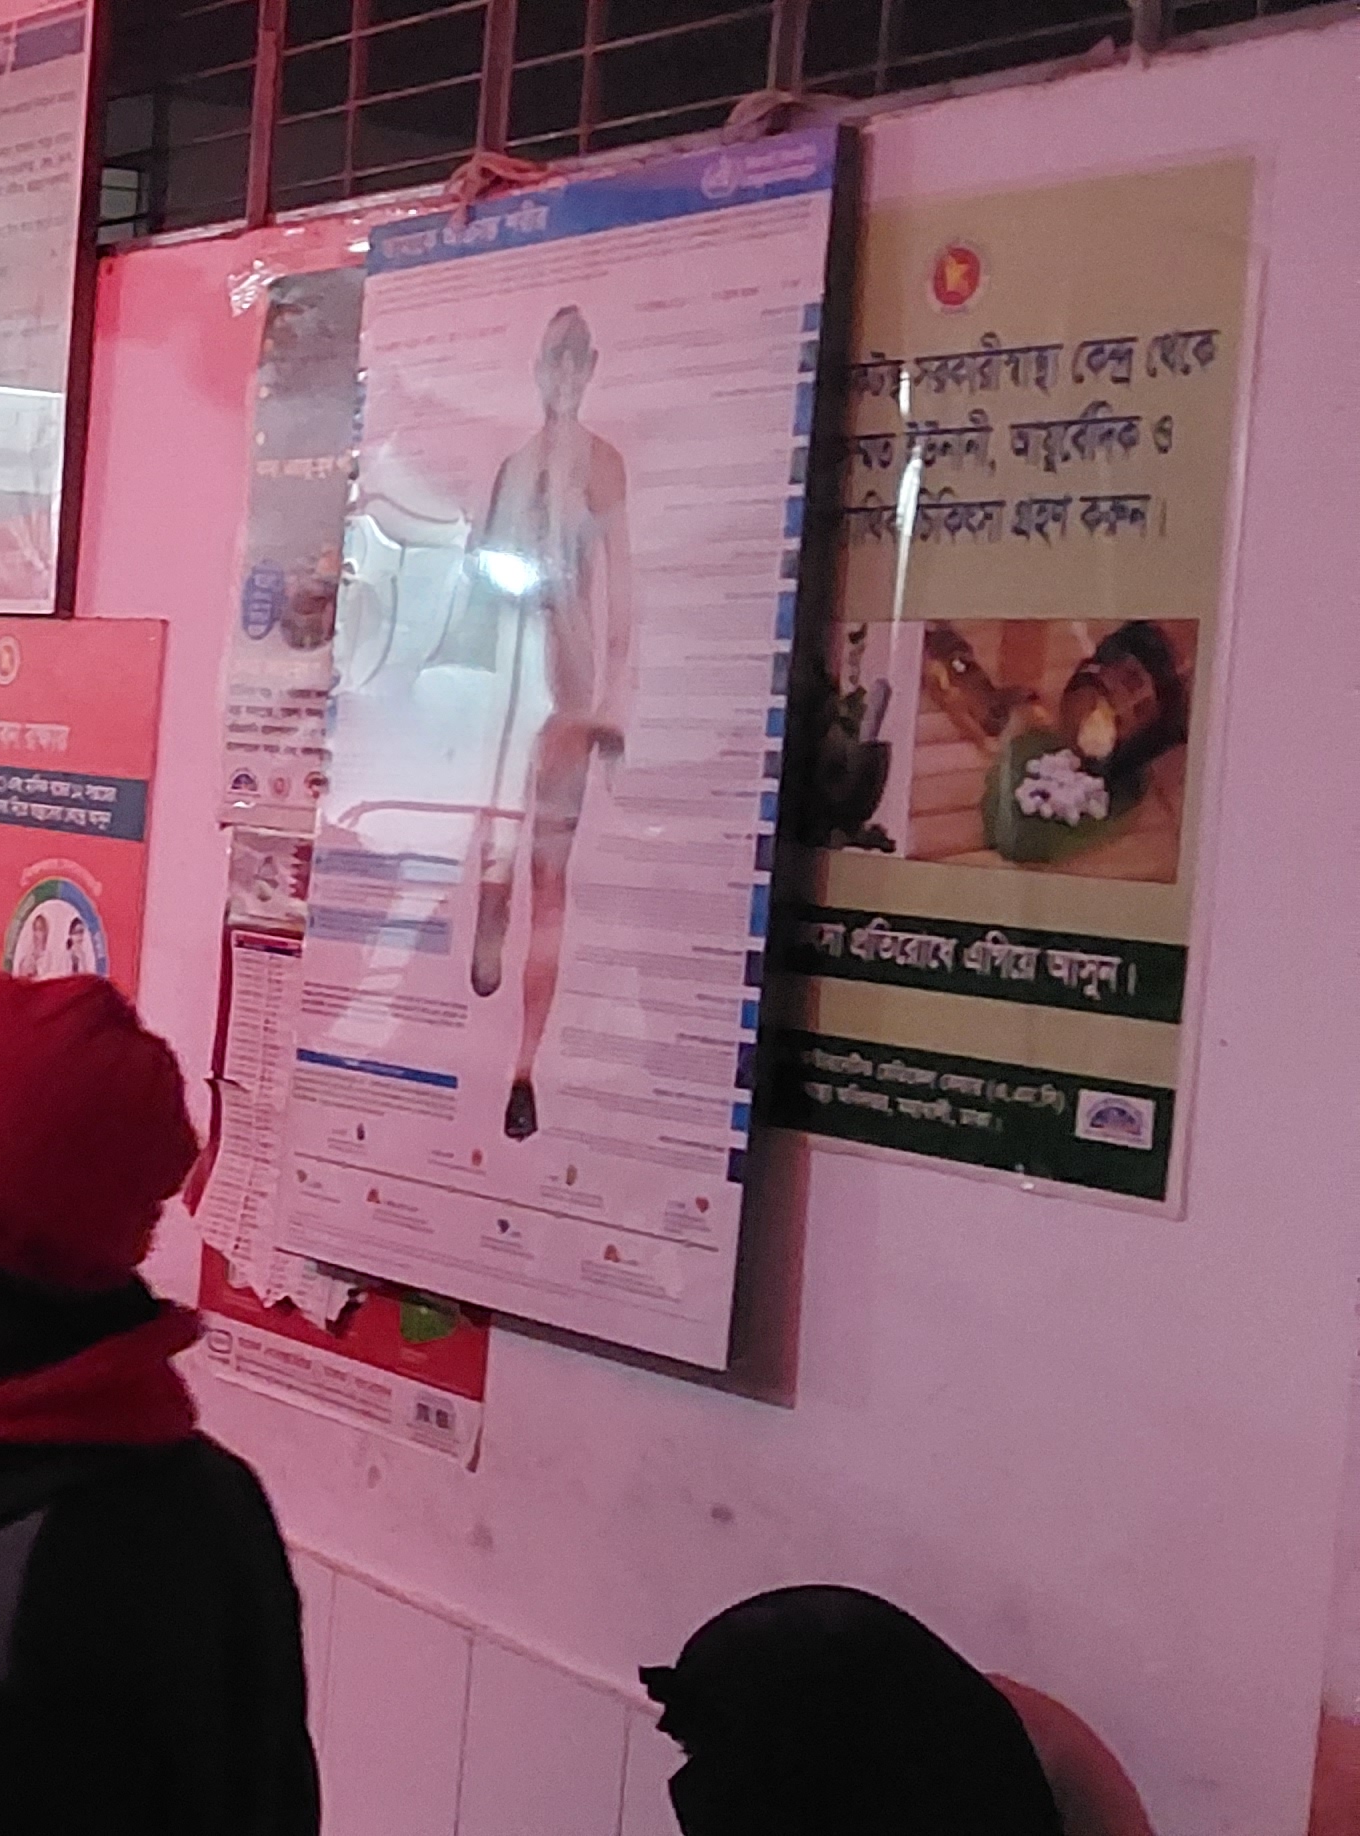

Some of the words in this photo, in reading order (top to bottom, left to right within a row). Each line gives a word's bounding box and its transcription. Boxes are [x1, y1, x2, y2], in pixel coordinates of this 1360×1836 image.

[1072, 336, 1138, 386] কেন্দ্র
[1146, 330, 1221, 378] থেকে
[1151, 415, 1174, 455] ও
[850, 917, 958, 974] প্রতিরোধে
[963, 930, 1041, 982] এগিয়ে
